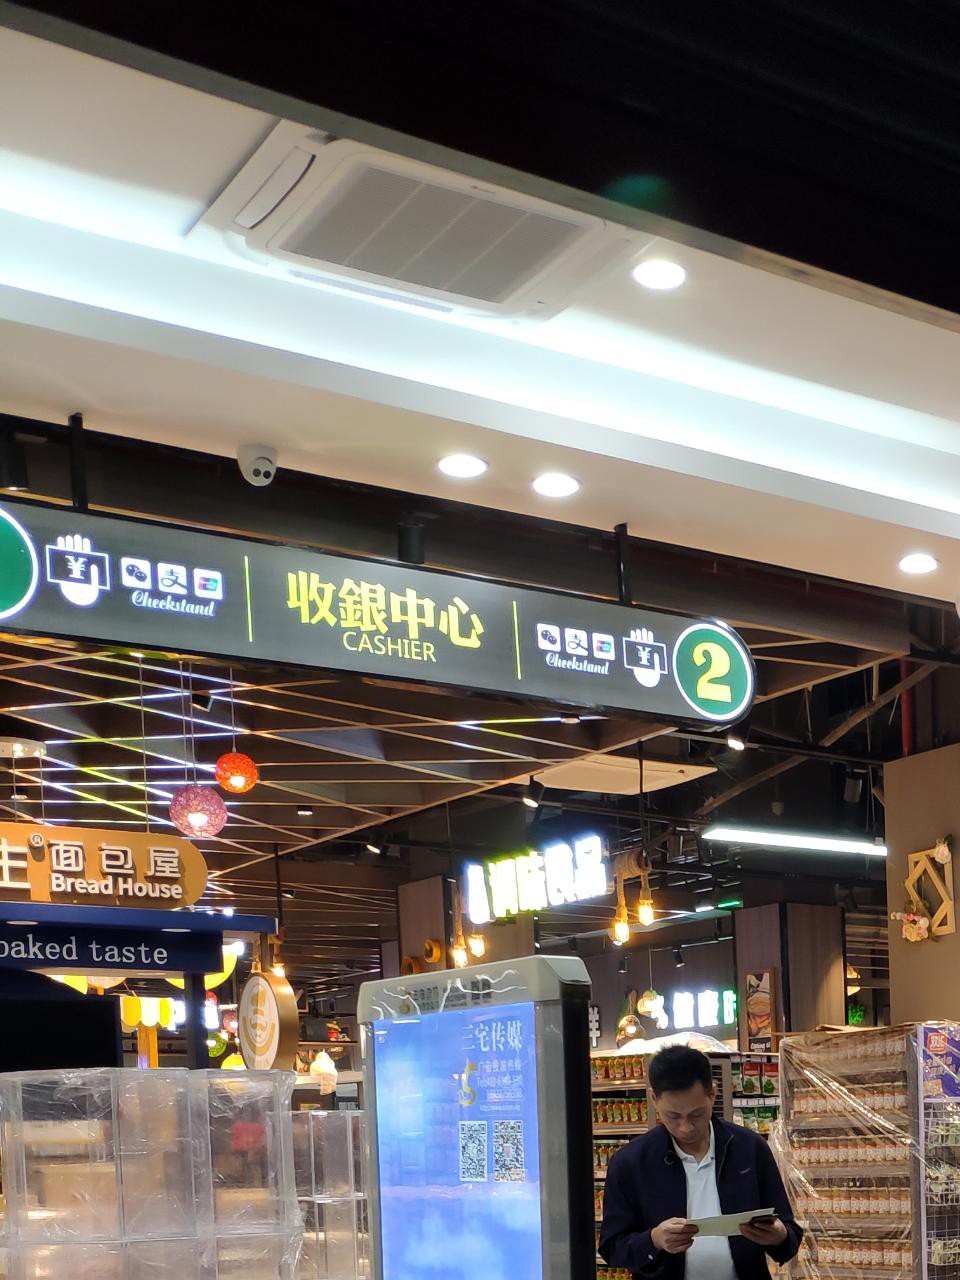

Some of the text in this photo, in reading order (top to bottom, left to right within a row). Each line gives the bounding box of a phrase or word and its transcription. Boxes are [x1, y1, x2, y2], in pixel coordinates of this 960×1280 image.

[131, 590, 215, 617] Checkstand
[287, 570, 485, 649] 收銀中心
[343, 631, 437, 663] CASHIER
[546, 652, 610, 675] Checkstand
[692, 641, 732, 703] 2
[48, 839, 182, 879] 面包屋
[51, 873, 183, 900] Bread House
[89, 941, 168, 965] taste
[461, 1020, 523, 1052] 三宅传媒
